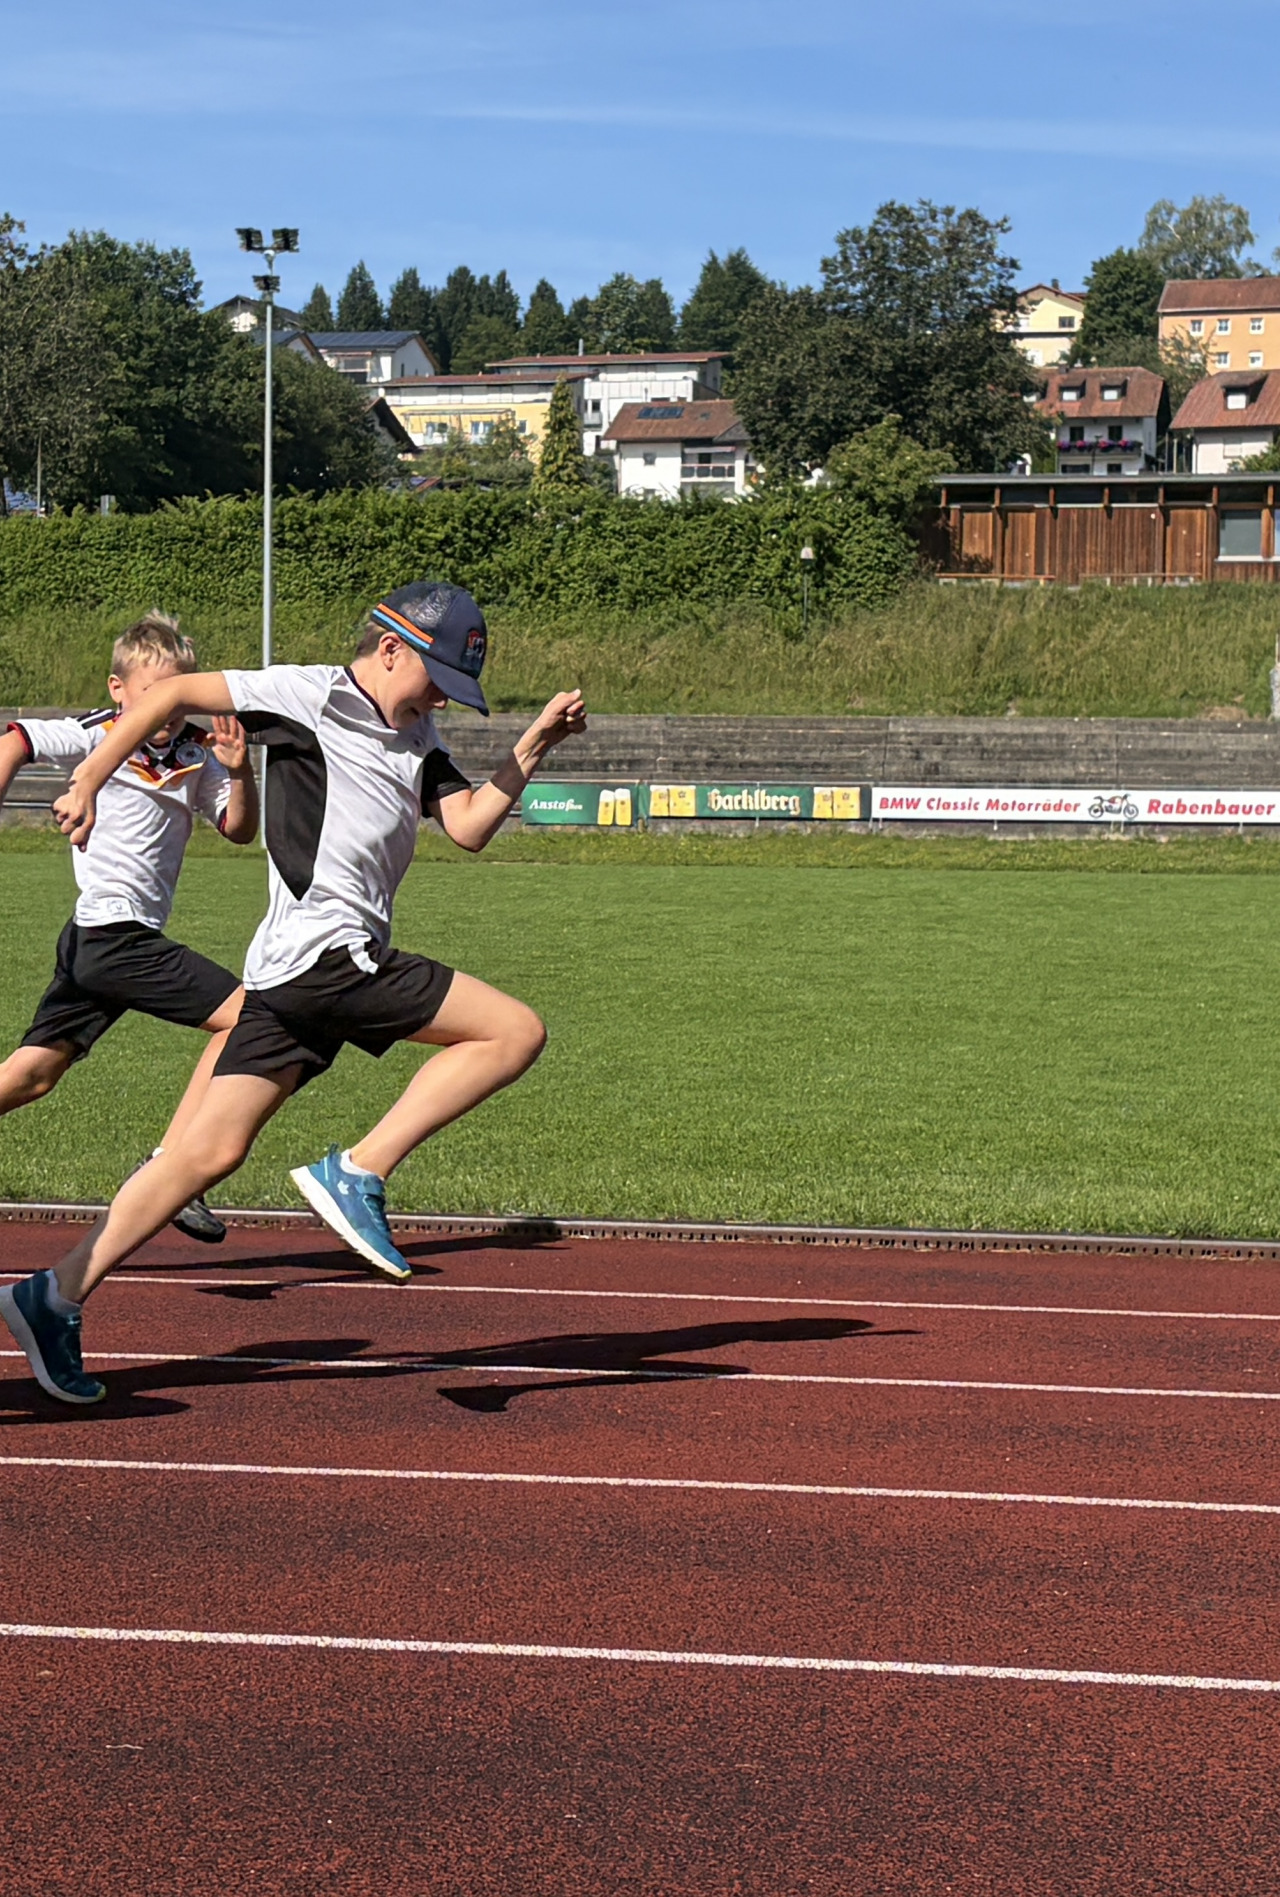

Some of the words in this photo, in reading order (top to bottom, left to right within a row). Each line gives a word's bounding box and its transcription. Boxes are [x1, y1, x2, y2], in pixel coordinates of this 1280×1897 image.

[707, 788, 801, 816] Hacklberg
[879, 797, 922, 811] BMW
[926, 797, 980, 811] Classic
[985, 798, 1081, 812] Motorräder
[1147, 798, 1276, 815] Rabenbauer
